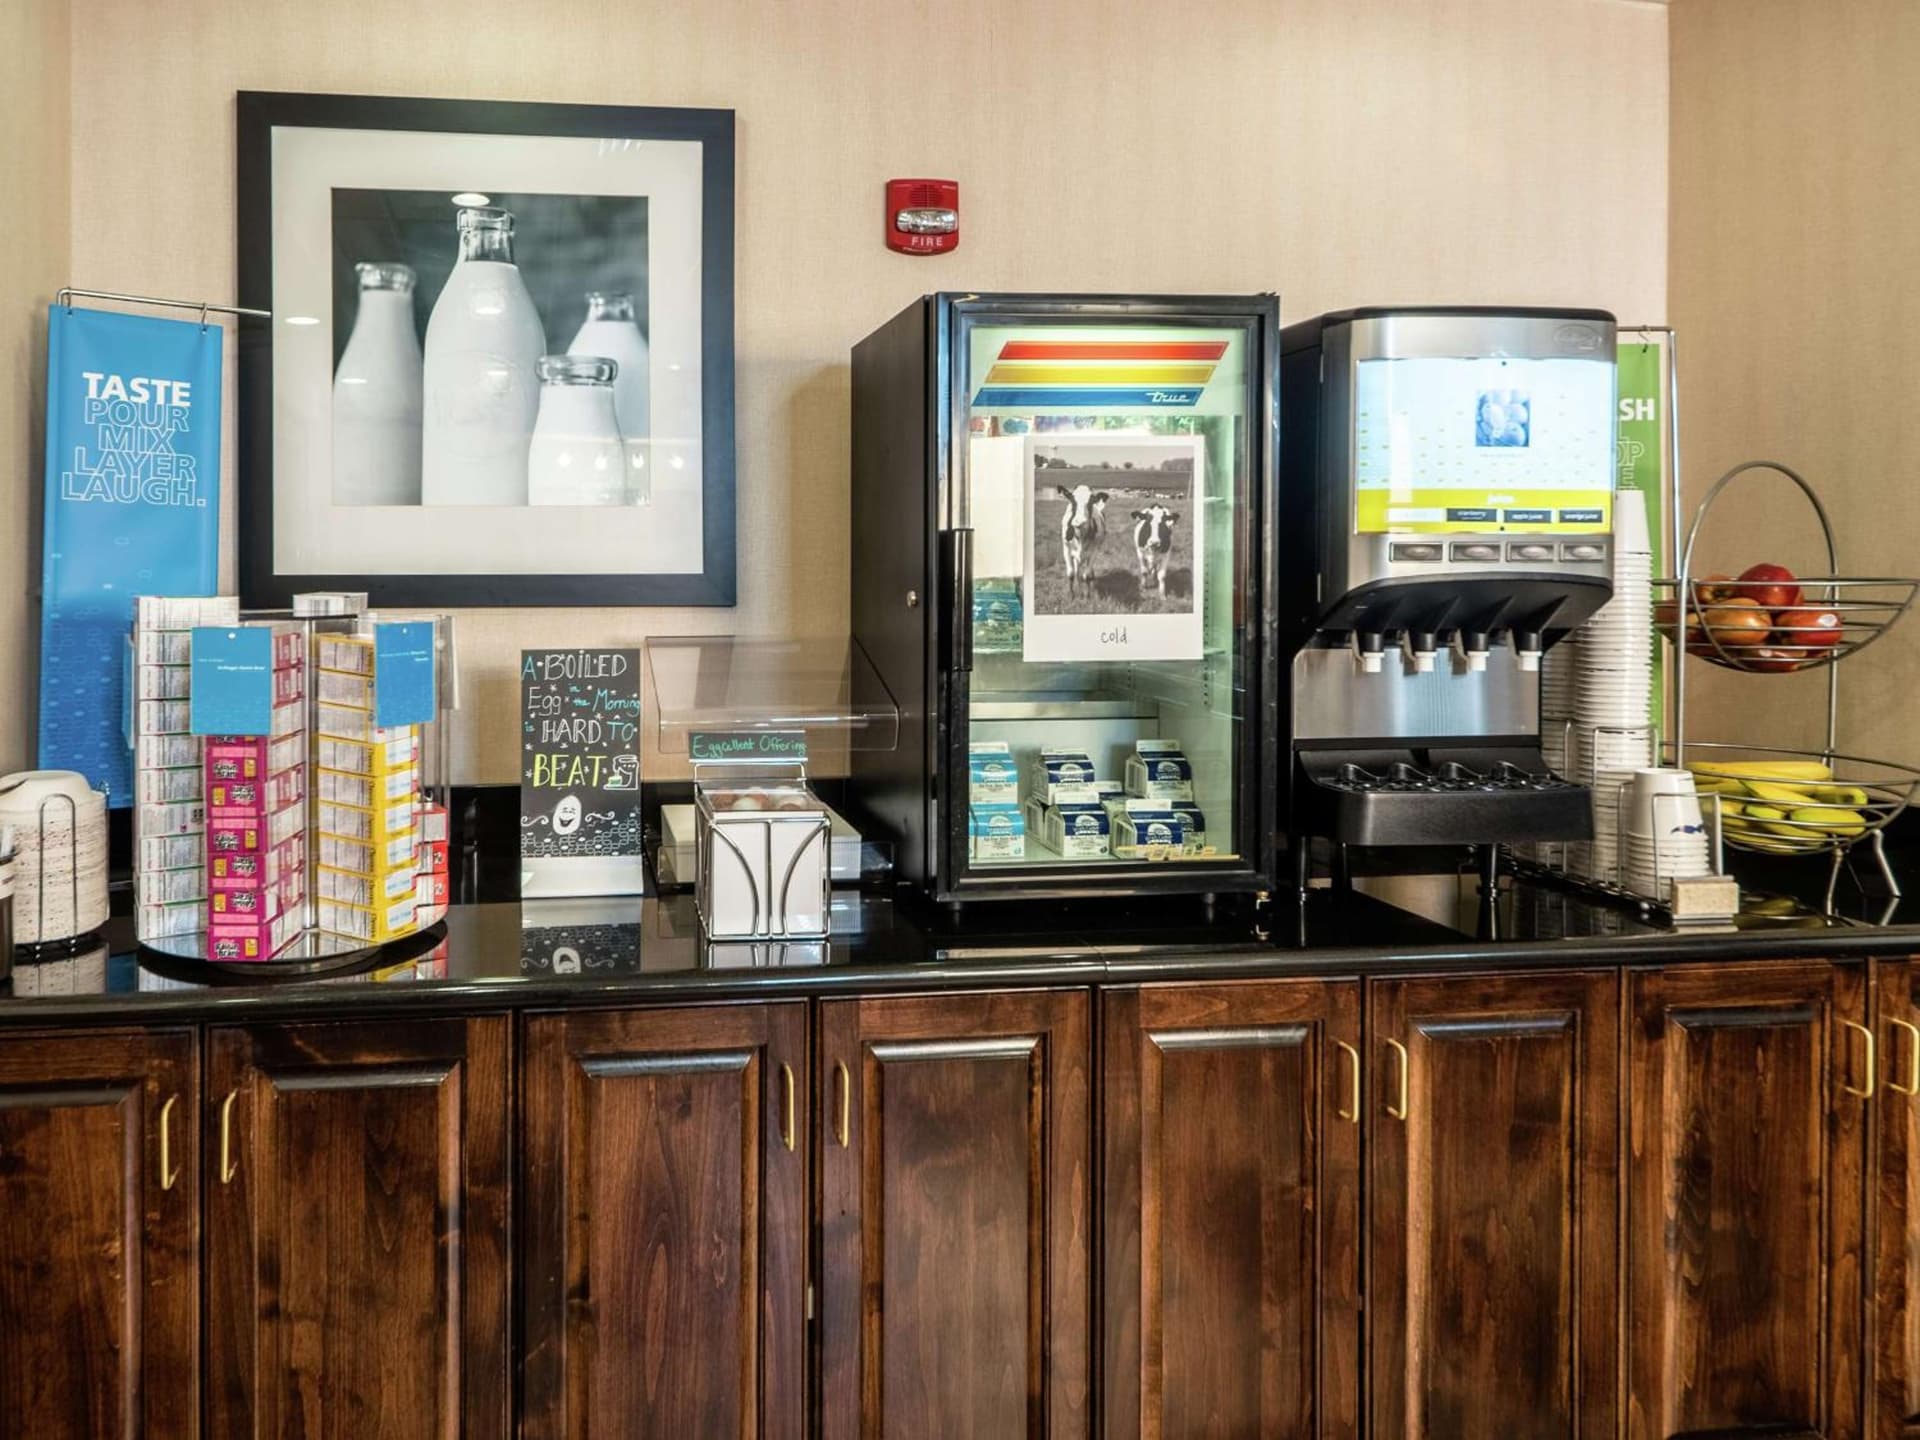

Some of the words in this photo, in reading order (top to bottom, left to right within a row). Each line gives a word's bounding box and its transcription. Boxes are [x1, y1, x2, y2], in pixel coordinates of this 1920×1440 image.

[911, 236, 943, 247] FIRE
[82, 372, 191, 407] TASTE
[84, 397, 190, 432] POUR
[1618, 397, 1655, 421] SH
[98, 423, 176, 455] MIX
[74, 447, 196, 482] LAYER
[61, 471, 207, 507] LAUGH.
[1100, 626, 1128, 645] cold
[521, 655, 537, 680] A
[544, 652, 627, 680] BOILED
[528, 686, 562, 716] Egg
[592, 687, 640, 717] Morning
[541, 718, 602, 744] HARD
[606, 720, 635, 741] TO
[533, 753, 608, 787] BEAT
